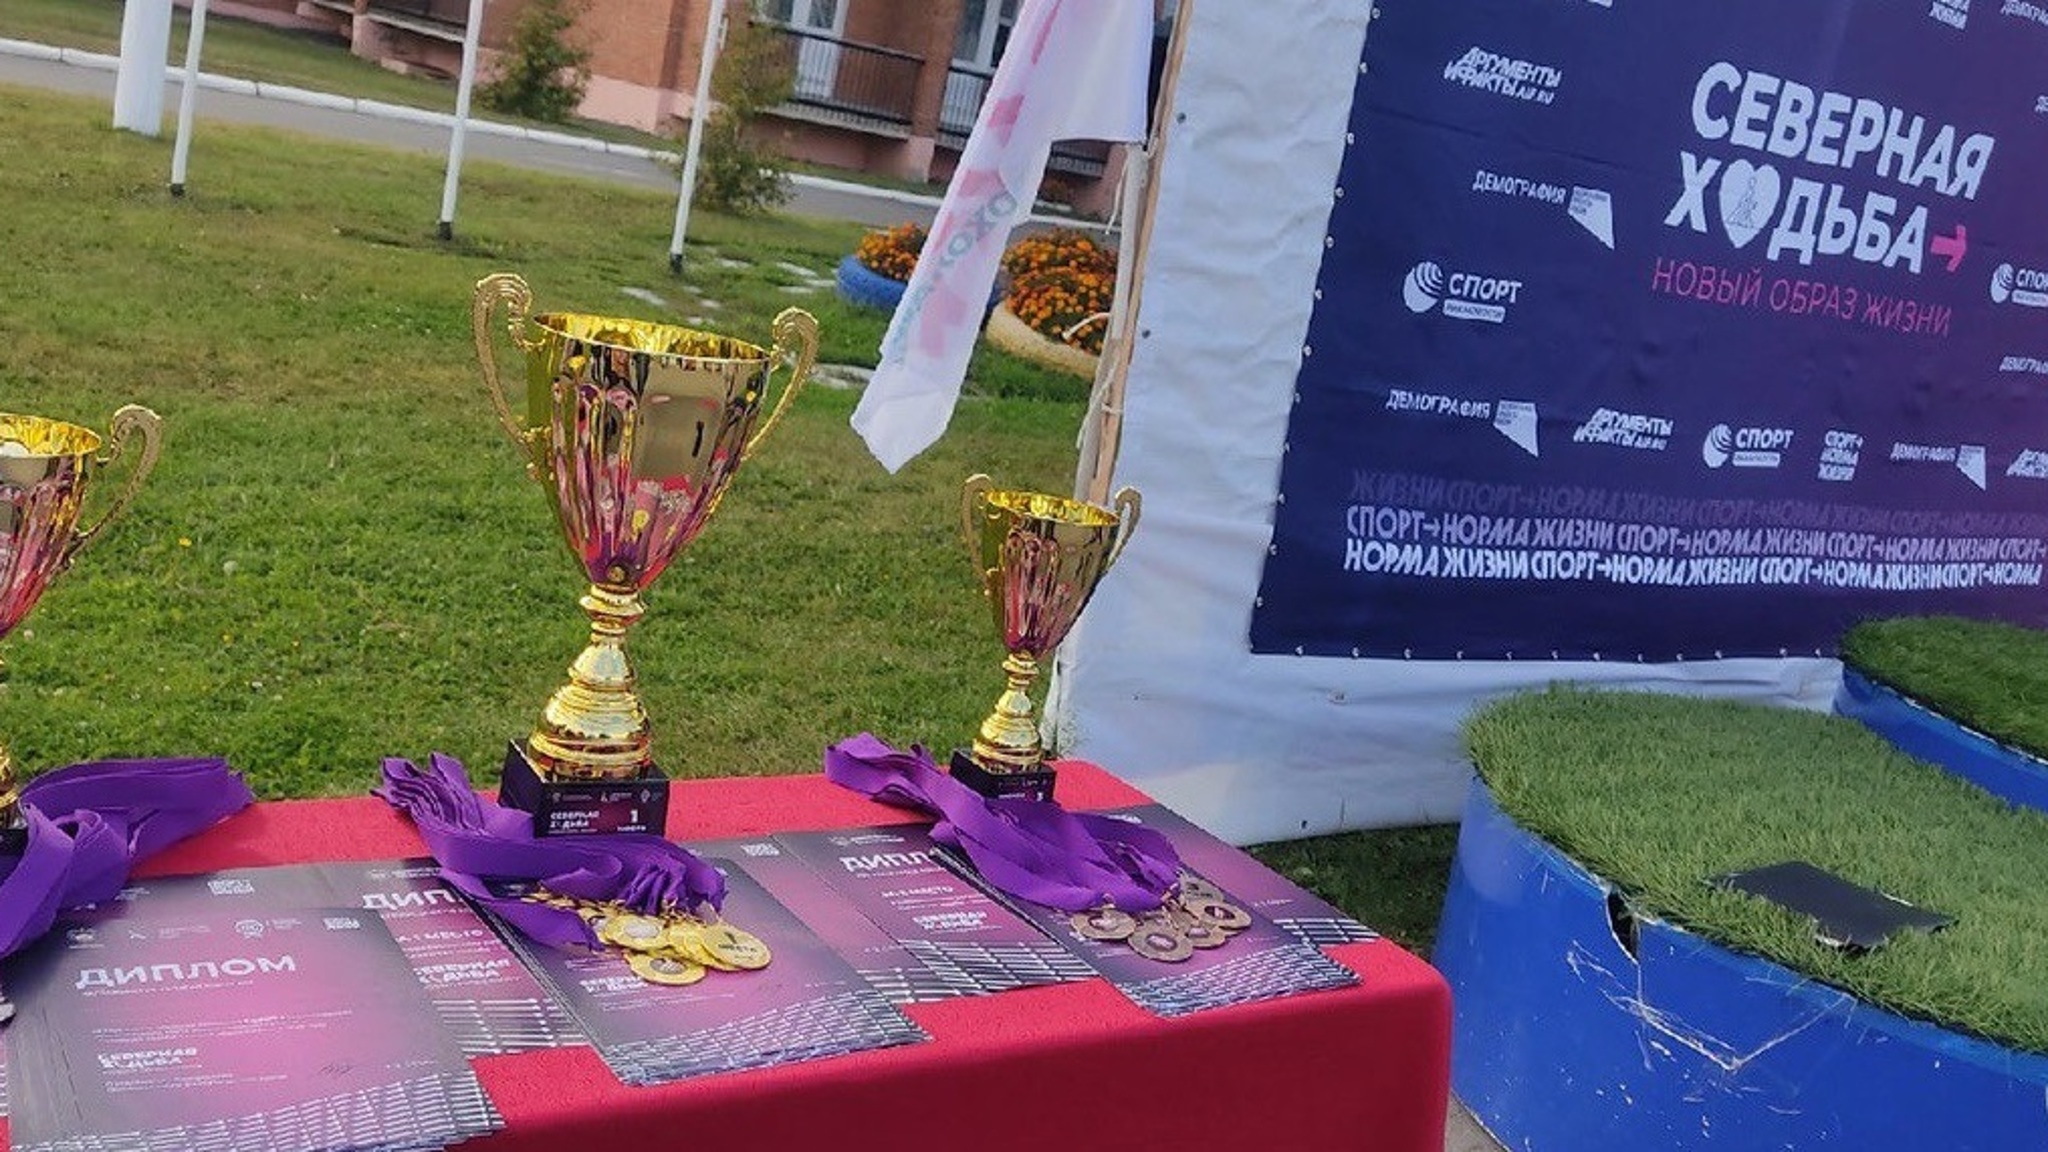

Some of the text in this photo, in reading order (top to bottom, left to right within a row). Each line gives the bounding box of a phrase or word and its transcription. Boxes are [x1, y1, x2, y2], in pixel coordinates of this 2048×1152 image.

[1692, 61, 1996, 200] СЕВЕРНАЯ
[1472, 169, 1567, 205] ДЕМОГРАФИЯ
[1449, 272, 1523, 303] СПОРТ
[1652, 257, 1952, 339] НОВЫЙ ОБРАЗ ЖИЗНИ
[1386, 388, 1491, 420] ДЕМОГРАФИЯ
[1591, 407, 1674, 436] АРГУМЕНТЫ
[1735, 428, 1794, 450] СПОРТ
[1351, 468, 1445, 505] ЖИЗНИ
[1447, 478, 1520, 513] СПОРТ
[1537, 484, 1619, 519] НОРМА
[1346, 505, 1423, 538] СПОРТ
[1442, 514, 1530, 546] НОРМА
[1531, 519, 1615, 551] ЖИЗНИ
[1616, 523, 1679, 556] СПОРТ
[1690, 529, 1763, 557] НОРМА
[1762, 529, 1827, 559] ЖИЗНИ
[1827, 532, 1876, 559] СПОРТ
[1884, 537, 1943, 561] НОРМА
[1945, 538, 1998, 561] ЖИЗНИ
[1343, 539, 1441, 576] НОРМА
[1441, 547, 1529, 579] ЖИЗНИ
[1529, 551, 1598, 580] СПОРТ
[1611, 553, 1688, 585] НОРМА
[1688, 556, 1760, 586] ЖИЗНИ
[1760, 557, 1813, 585] СПОРТ
[1823, 563, 1883, 589] НОРМА
[1882, 565, 1941, 590] ЖИЗНИ
[630, 809, 639, 823] 1
[75, 955, 297, 990] ДИПЛОМ
